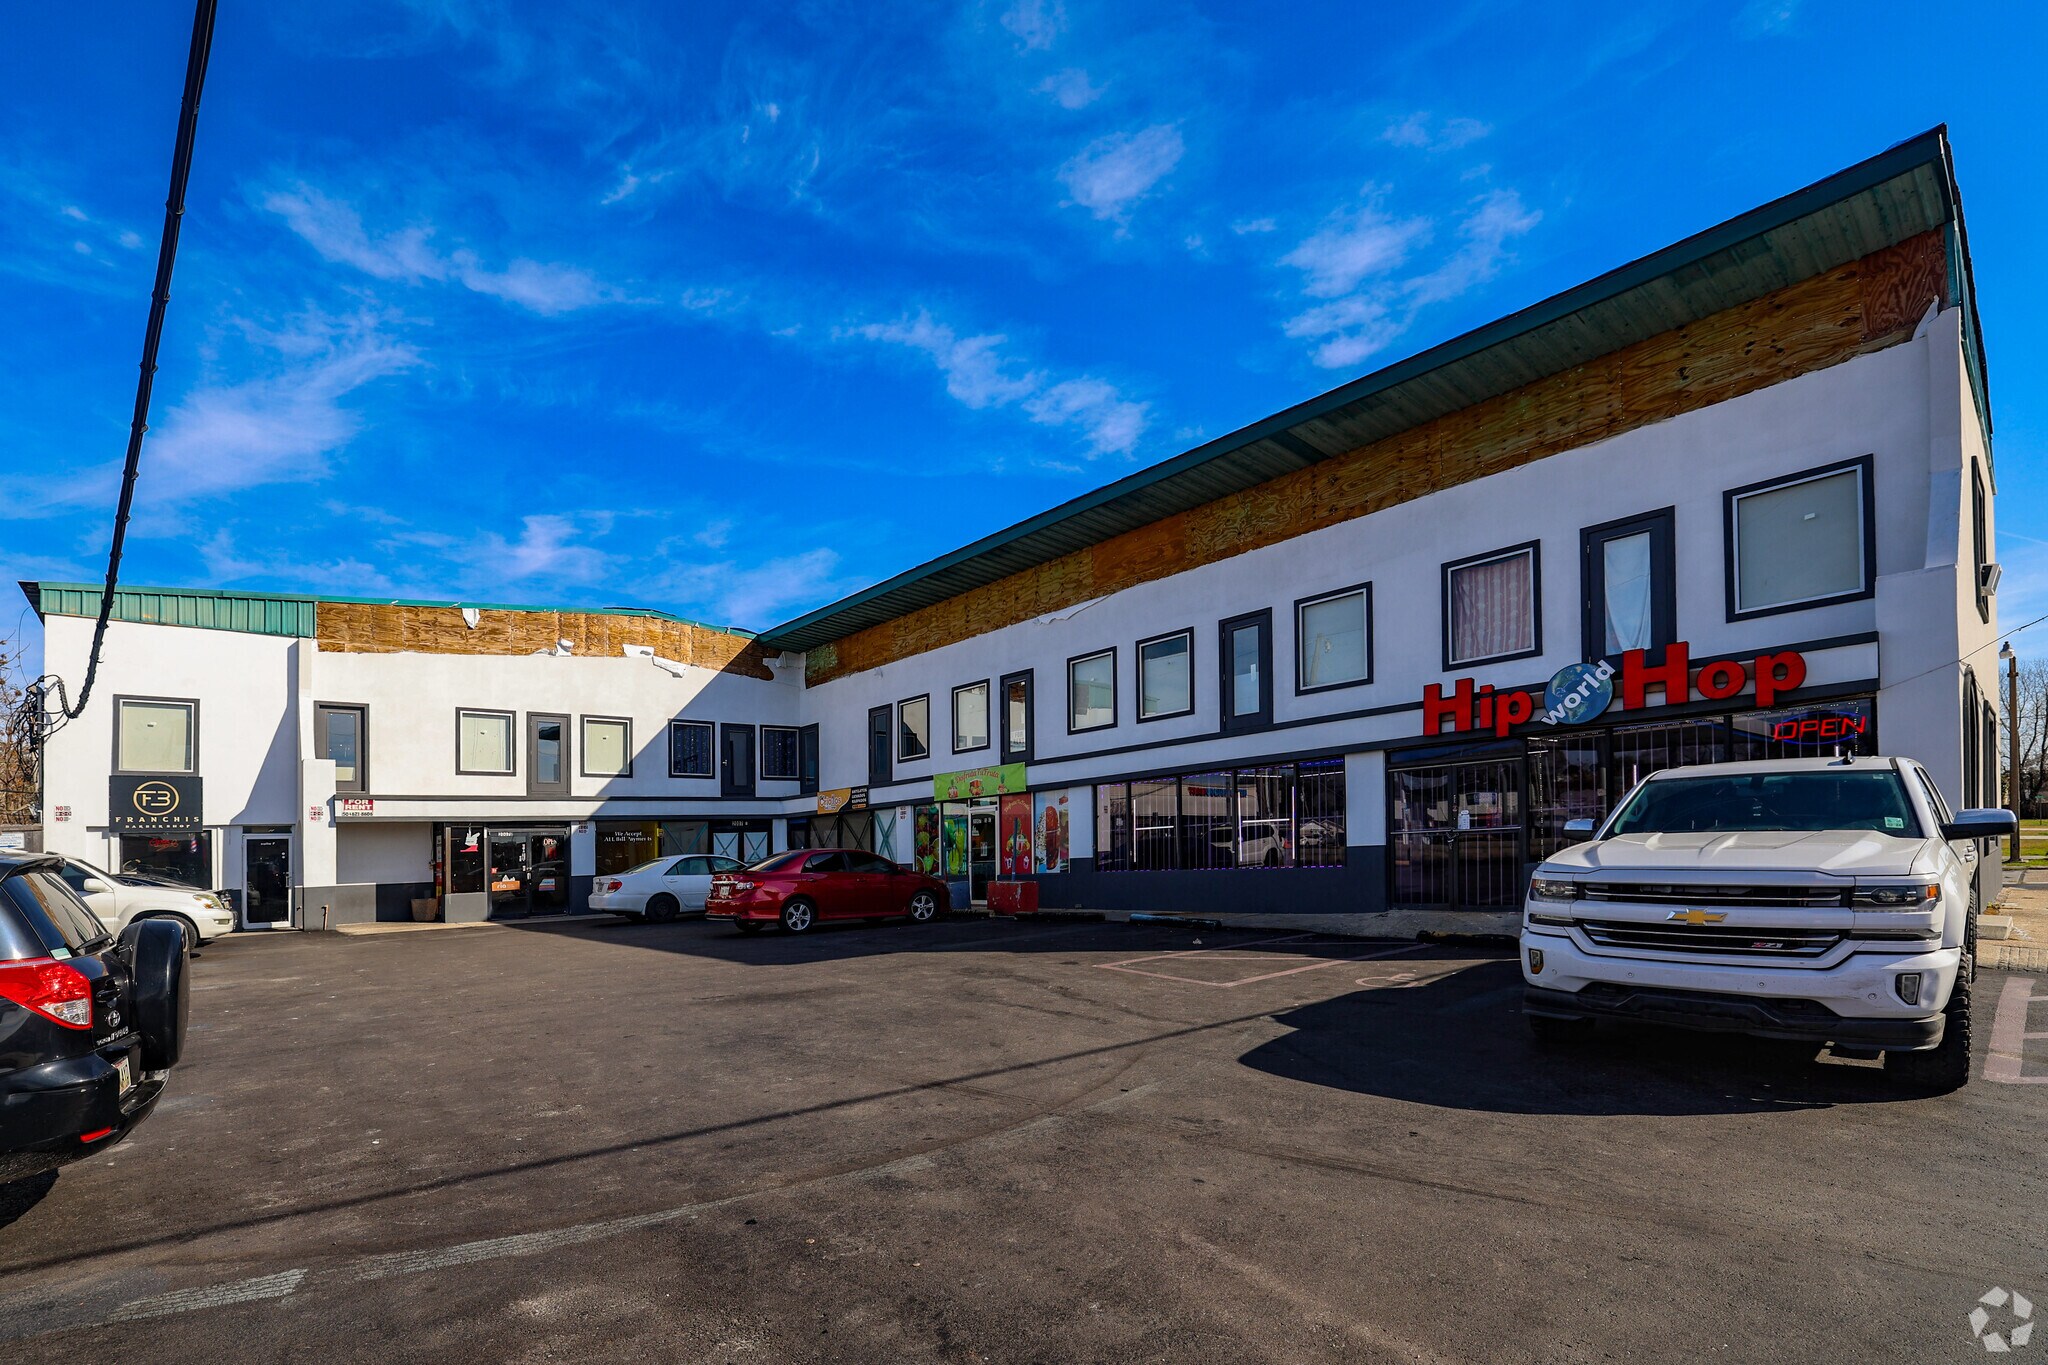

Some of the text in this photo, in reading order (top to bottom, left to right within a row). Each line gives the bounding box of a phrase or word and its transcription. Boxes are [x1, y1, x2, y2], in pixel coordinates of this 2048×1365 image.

[1423, 641, 1807, 738] Hip world Hop
[1774, 715, 1867, 741] OPEN
